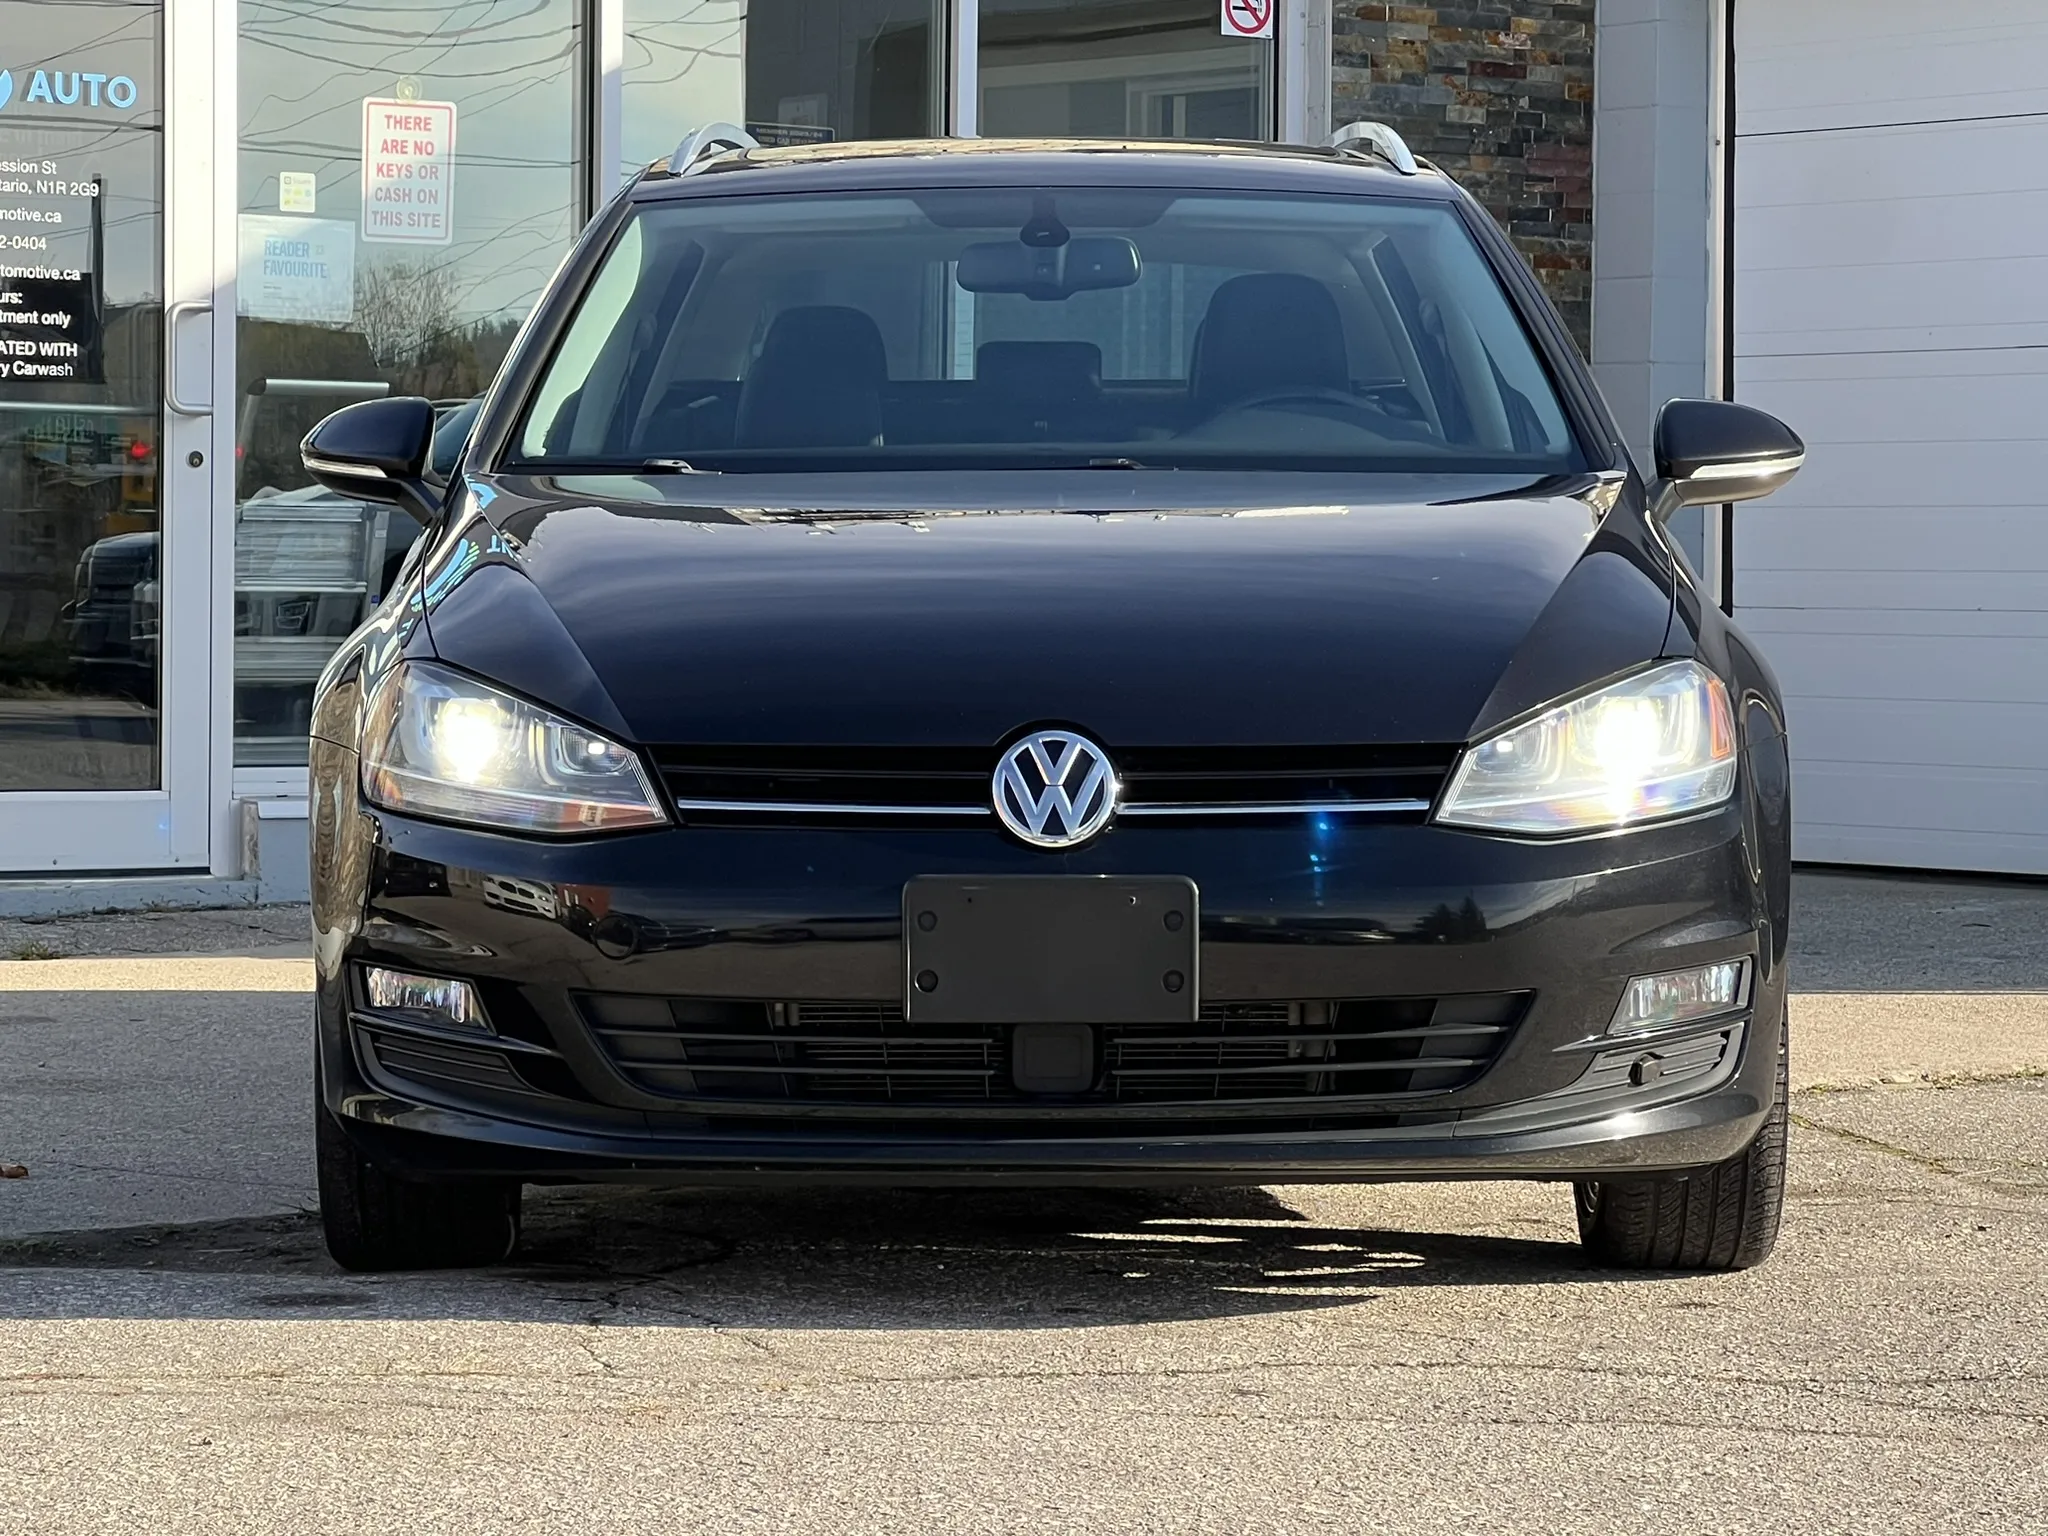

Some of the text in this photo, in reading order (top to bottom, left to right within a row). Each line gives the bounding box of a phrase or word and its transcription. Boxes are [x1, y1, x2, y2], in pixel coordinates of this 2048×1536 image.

[27, 70, 137, 108] AUTO
[384, 114, 433, 132] THERE
[380, 138, 435, 156] ARE NO
[42, 160, 57, 175] St
[376, 162, 439, 180] KEYS OR
[36, 180, 66, 195] N1R
[70, 182, 99, 197] 2G9
[374, 187, 439, 204] CASH ON
[371, 210, 441, 228] THIS SITE
[264, 239, 310, 258] READER
[263, 260, 328, 279] FAVOURITE
[41, 311, 71, 329] only
[39, 342, 78, 357] WITH
[13, 360, 74, 377] Carwash
